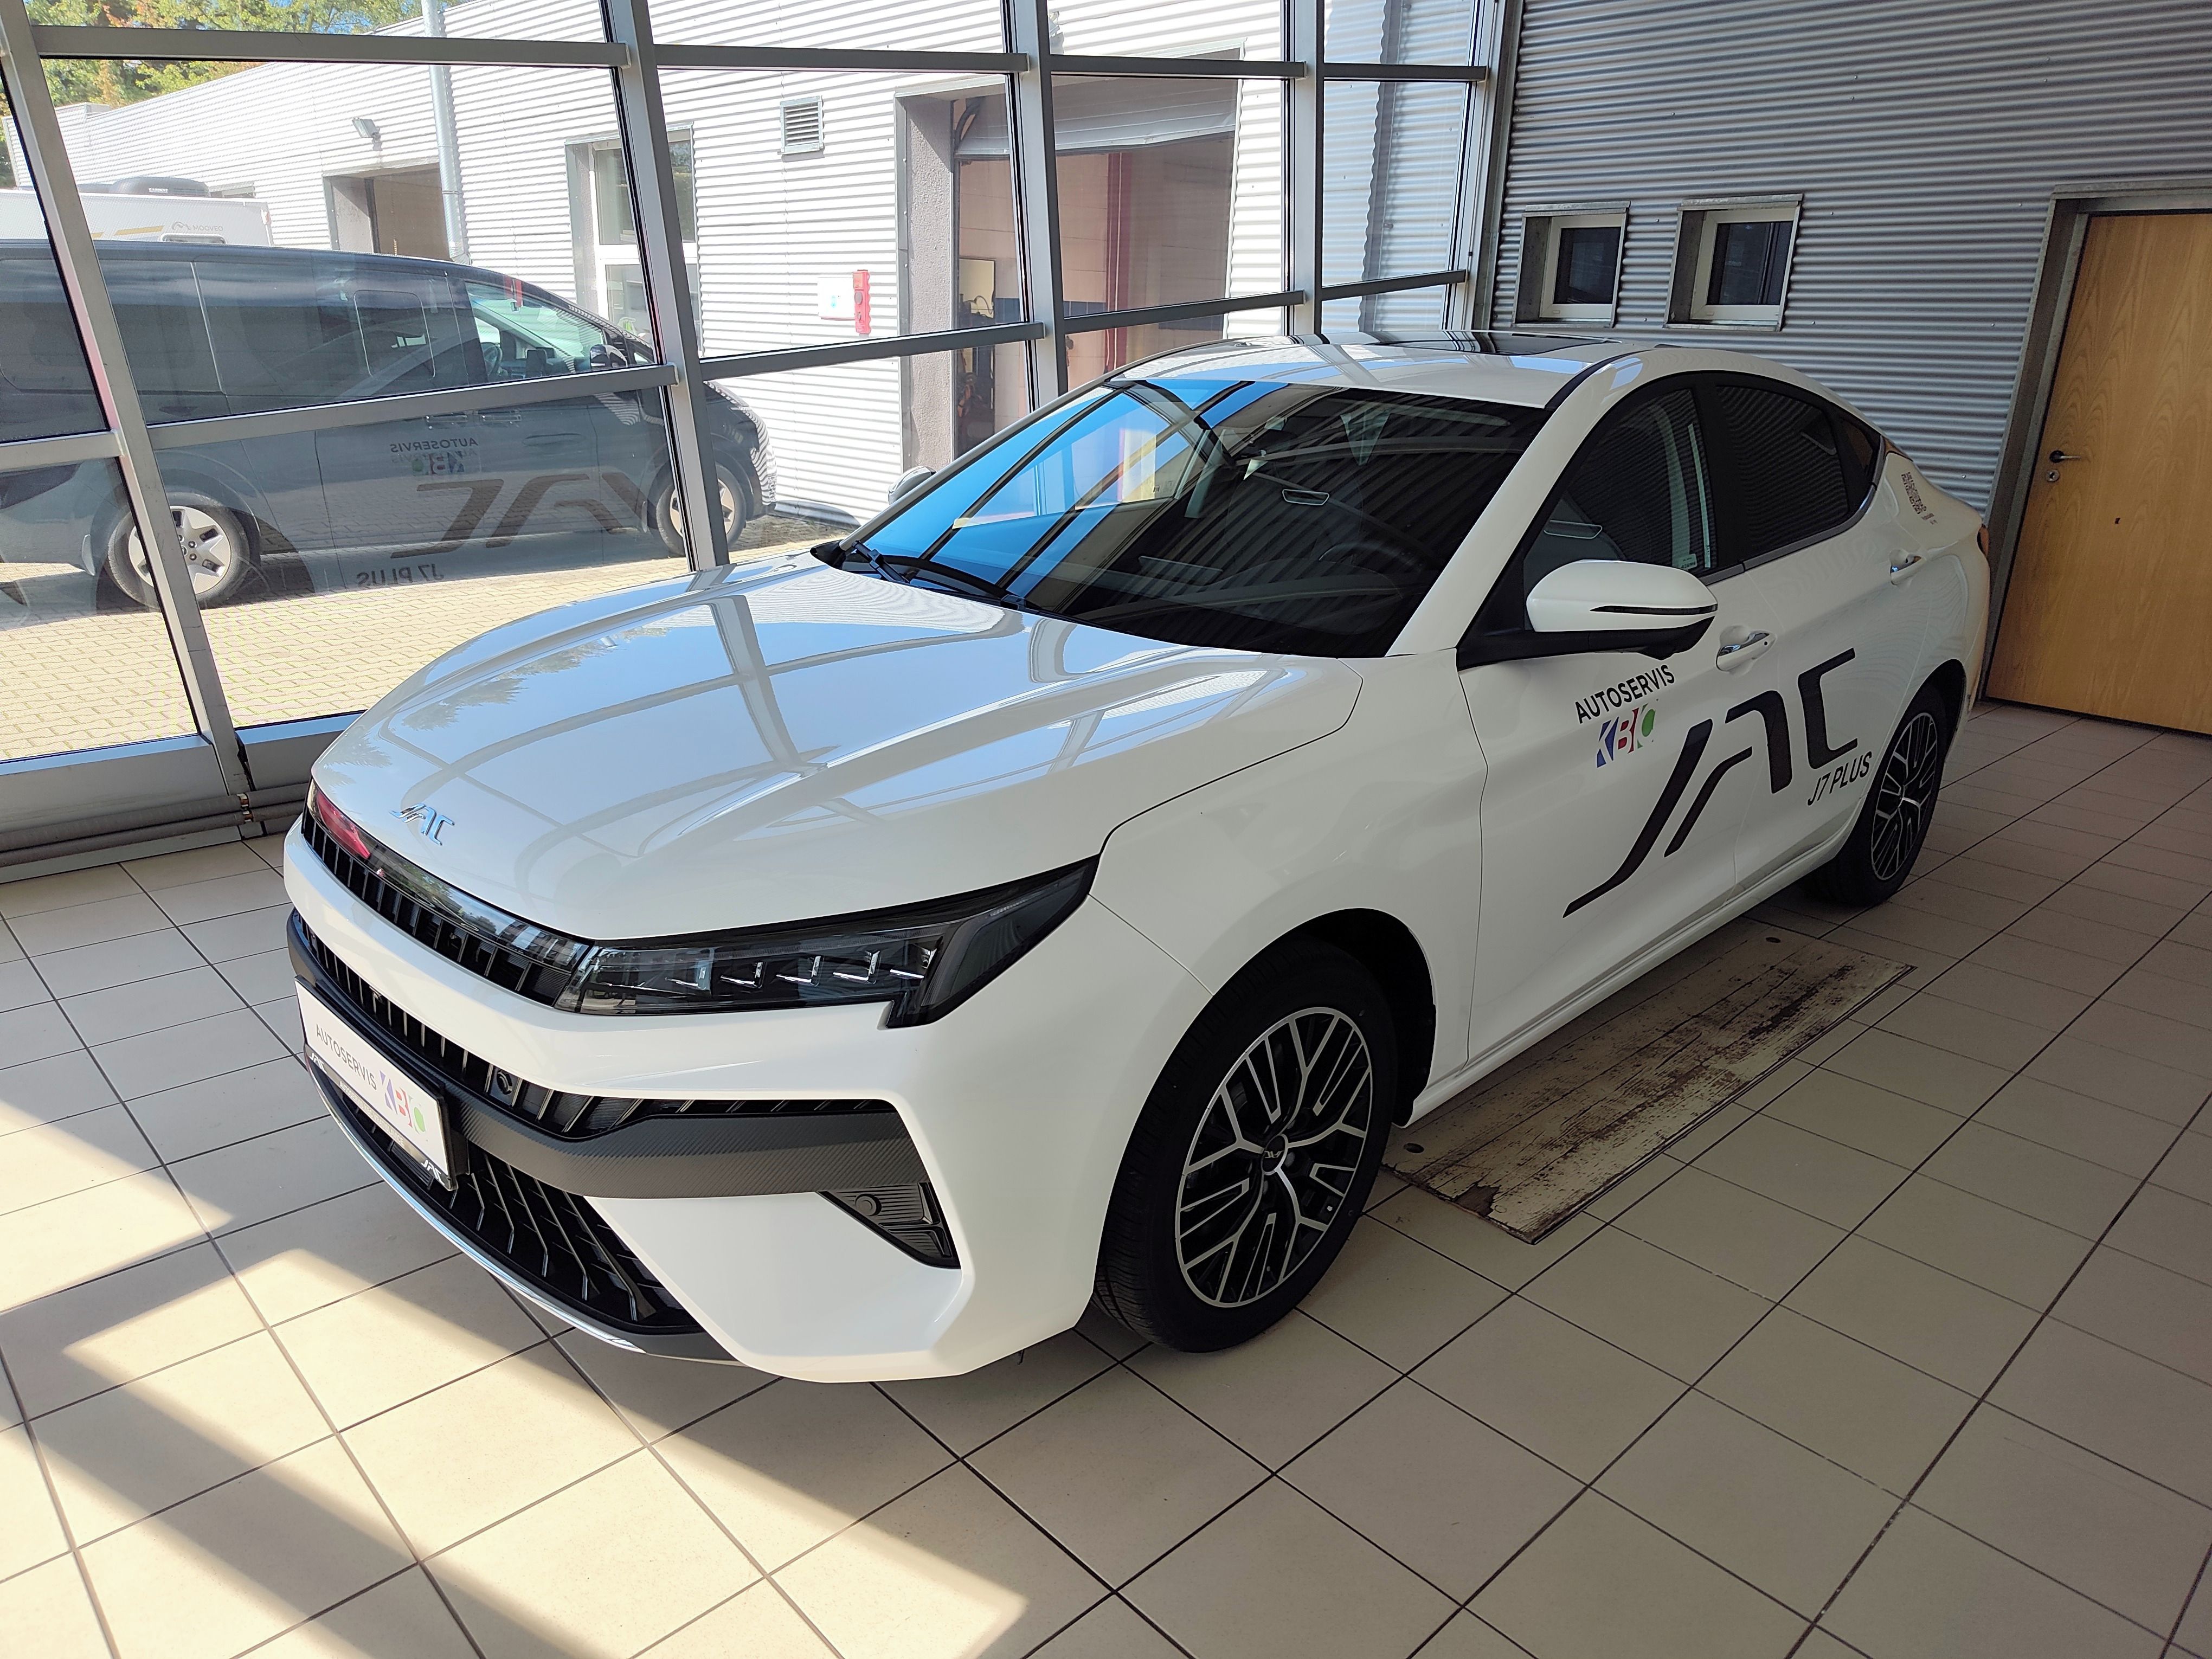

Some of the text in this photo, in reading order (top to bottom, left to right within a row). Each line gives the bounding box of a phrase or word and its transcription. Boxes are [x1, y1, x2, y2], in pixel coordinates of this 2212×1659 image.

[1575, 665, 1675, 724] AUTOSERVIS
[1807, 751, 1873, 806] J7 PLUS
[316, 1024, 377, 1090] AUTOSERVIS
